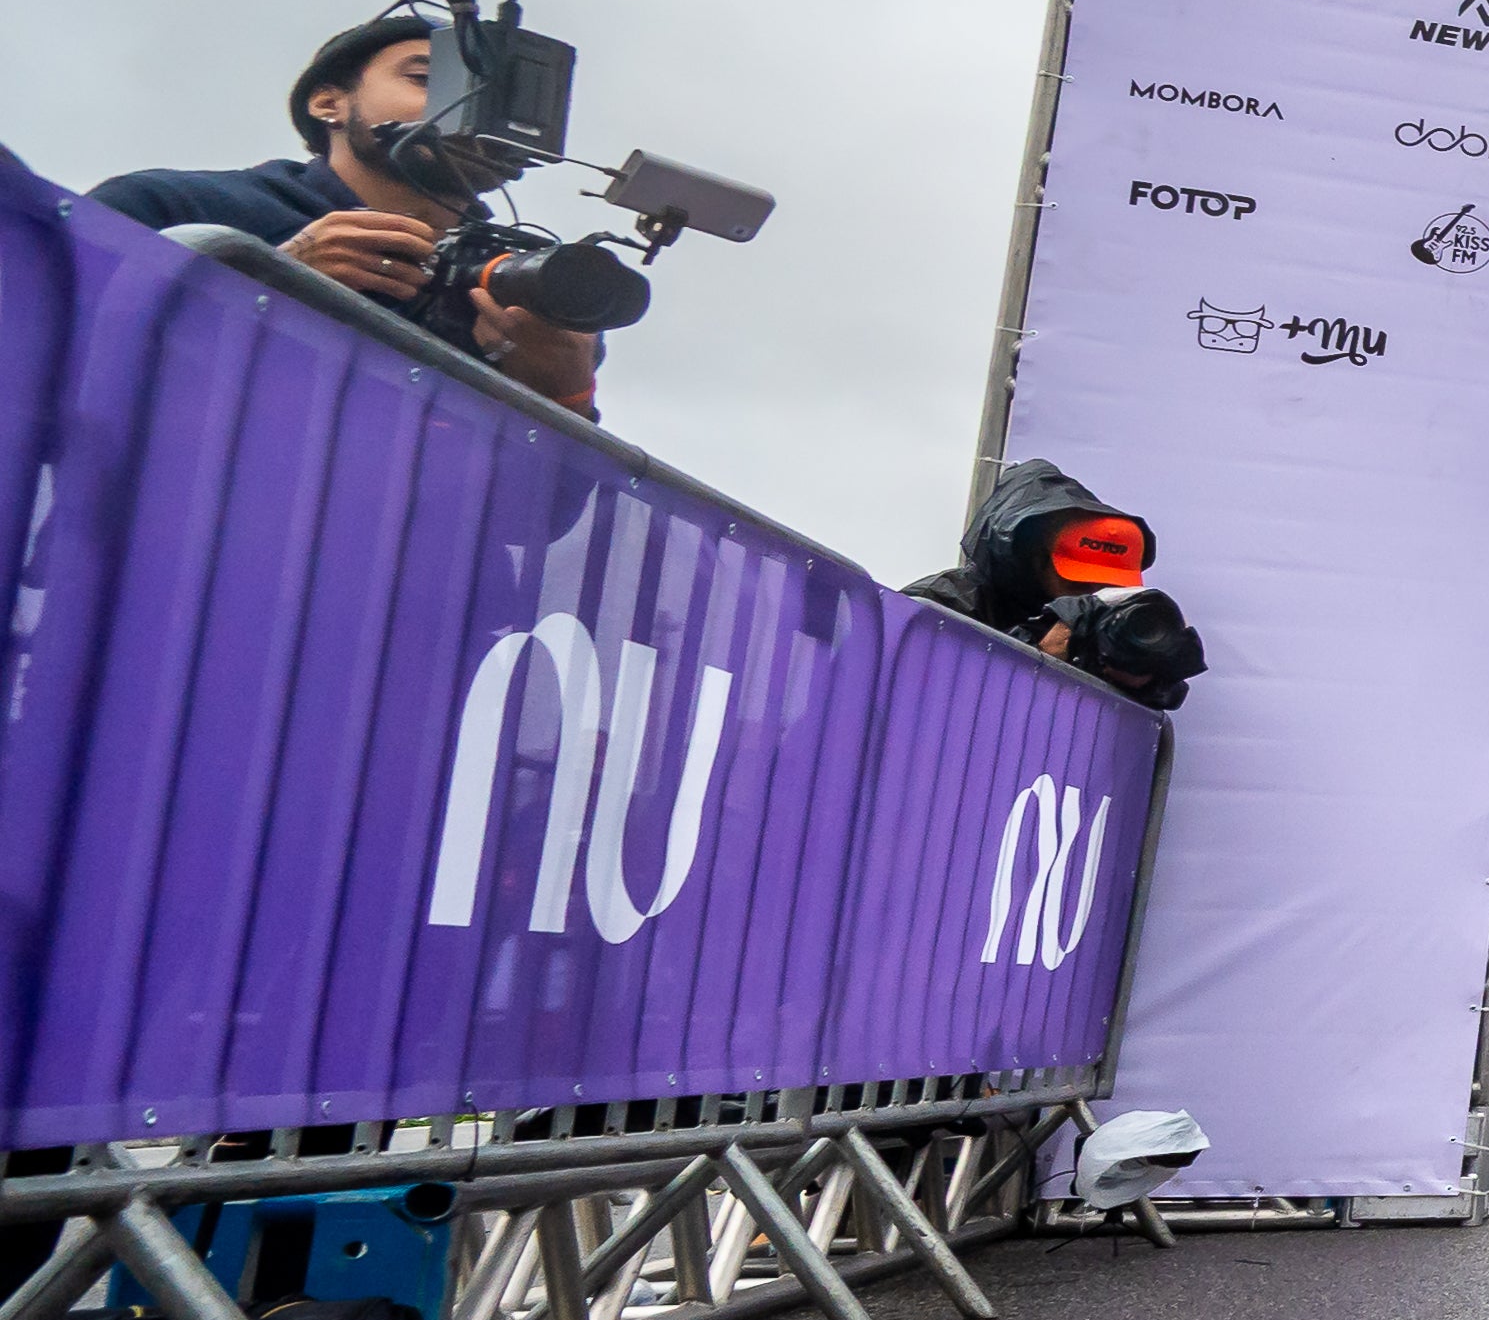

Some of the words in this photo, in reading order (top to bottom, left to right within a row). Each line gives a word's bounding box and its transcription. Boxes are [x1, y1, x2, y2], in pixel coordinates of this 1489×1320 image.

[1129, 78, 1285, 121] MOMBORA
[1128, 180, 1257, 221] FOTOP
[1451, 248, 1477, 266] FM
